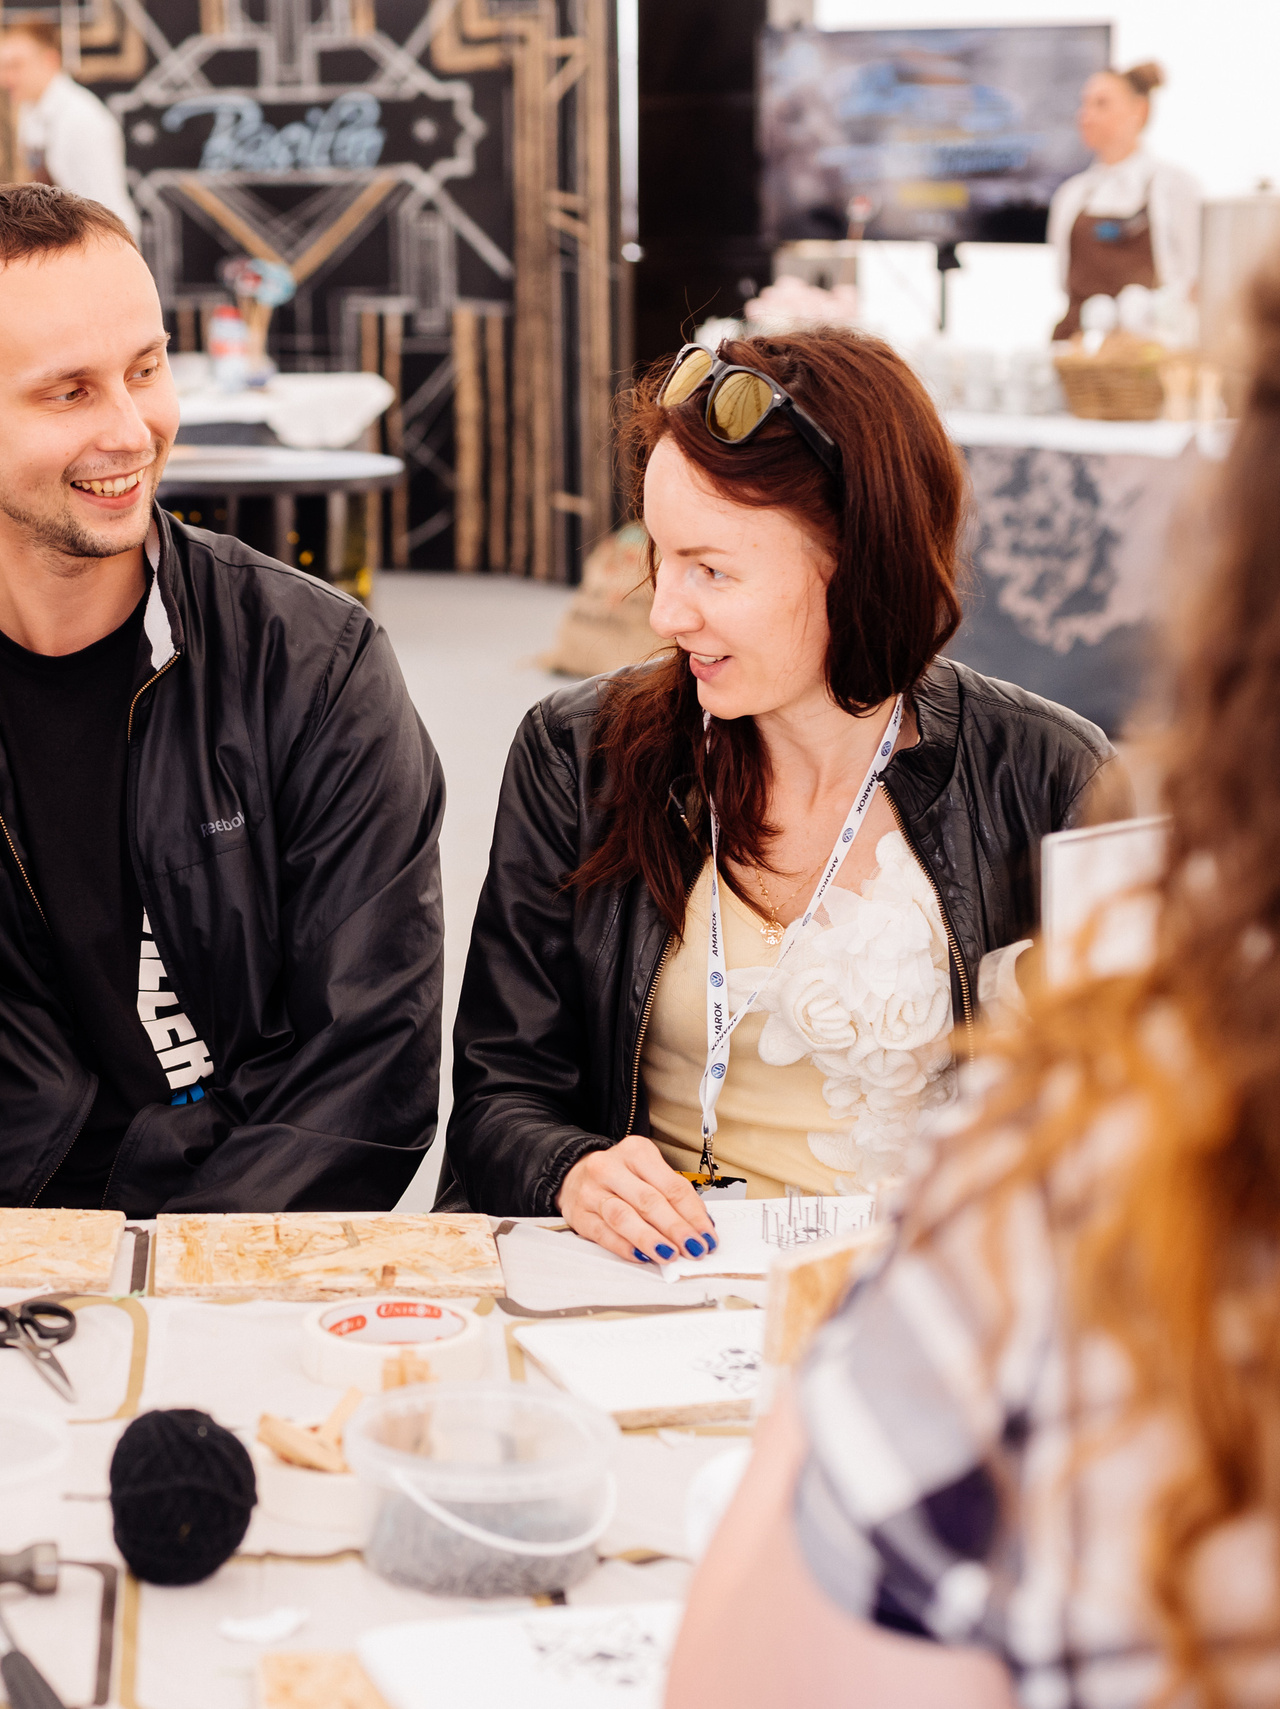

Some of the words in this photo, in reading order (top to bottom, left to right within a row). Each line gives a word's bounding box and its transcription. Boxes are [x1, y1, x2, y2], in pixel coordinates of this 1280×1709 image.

[856, 769, 879, 815] AMAROK
[816, 856, 839, 899] AMAROK
[711, 910, 719, 957] AMAROK
